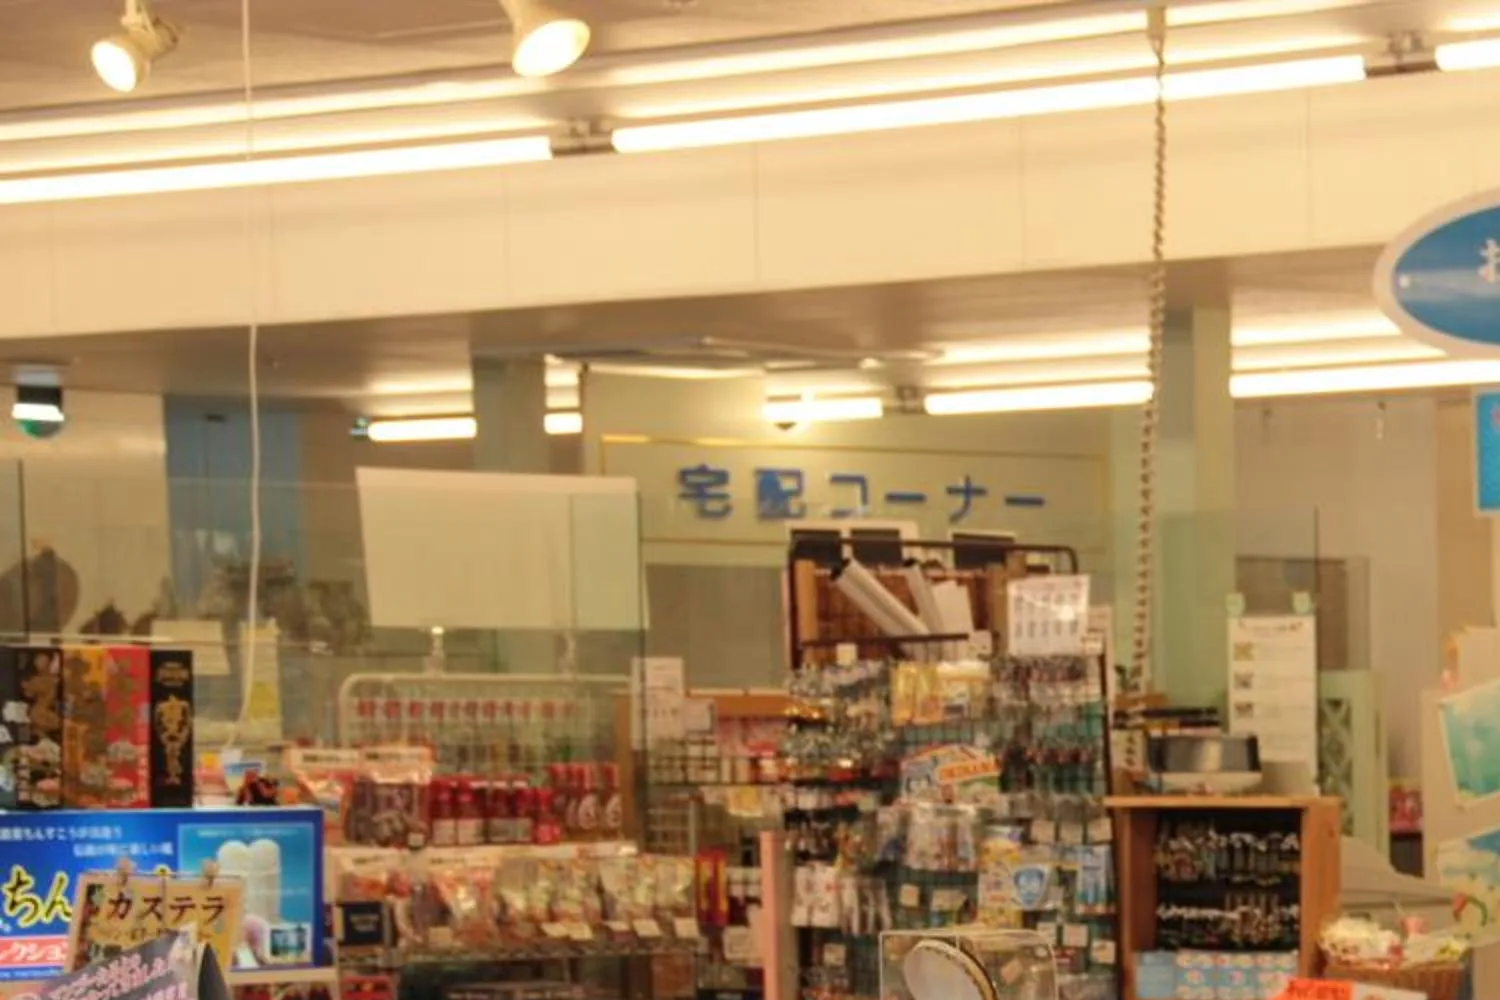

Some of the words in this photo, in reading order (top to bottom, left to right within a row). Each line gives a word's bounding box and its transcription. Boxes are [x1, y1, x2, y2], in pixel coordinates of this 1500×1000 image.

[677, 464, 1045, 523] 宅配コーナー
[107, 891, 225, 924] カステラ
